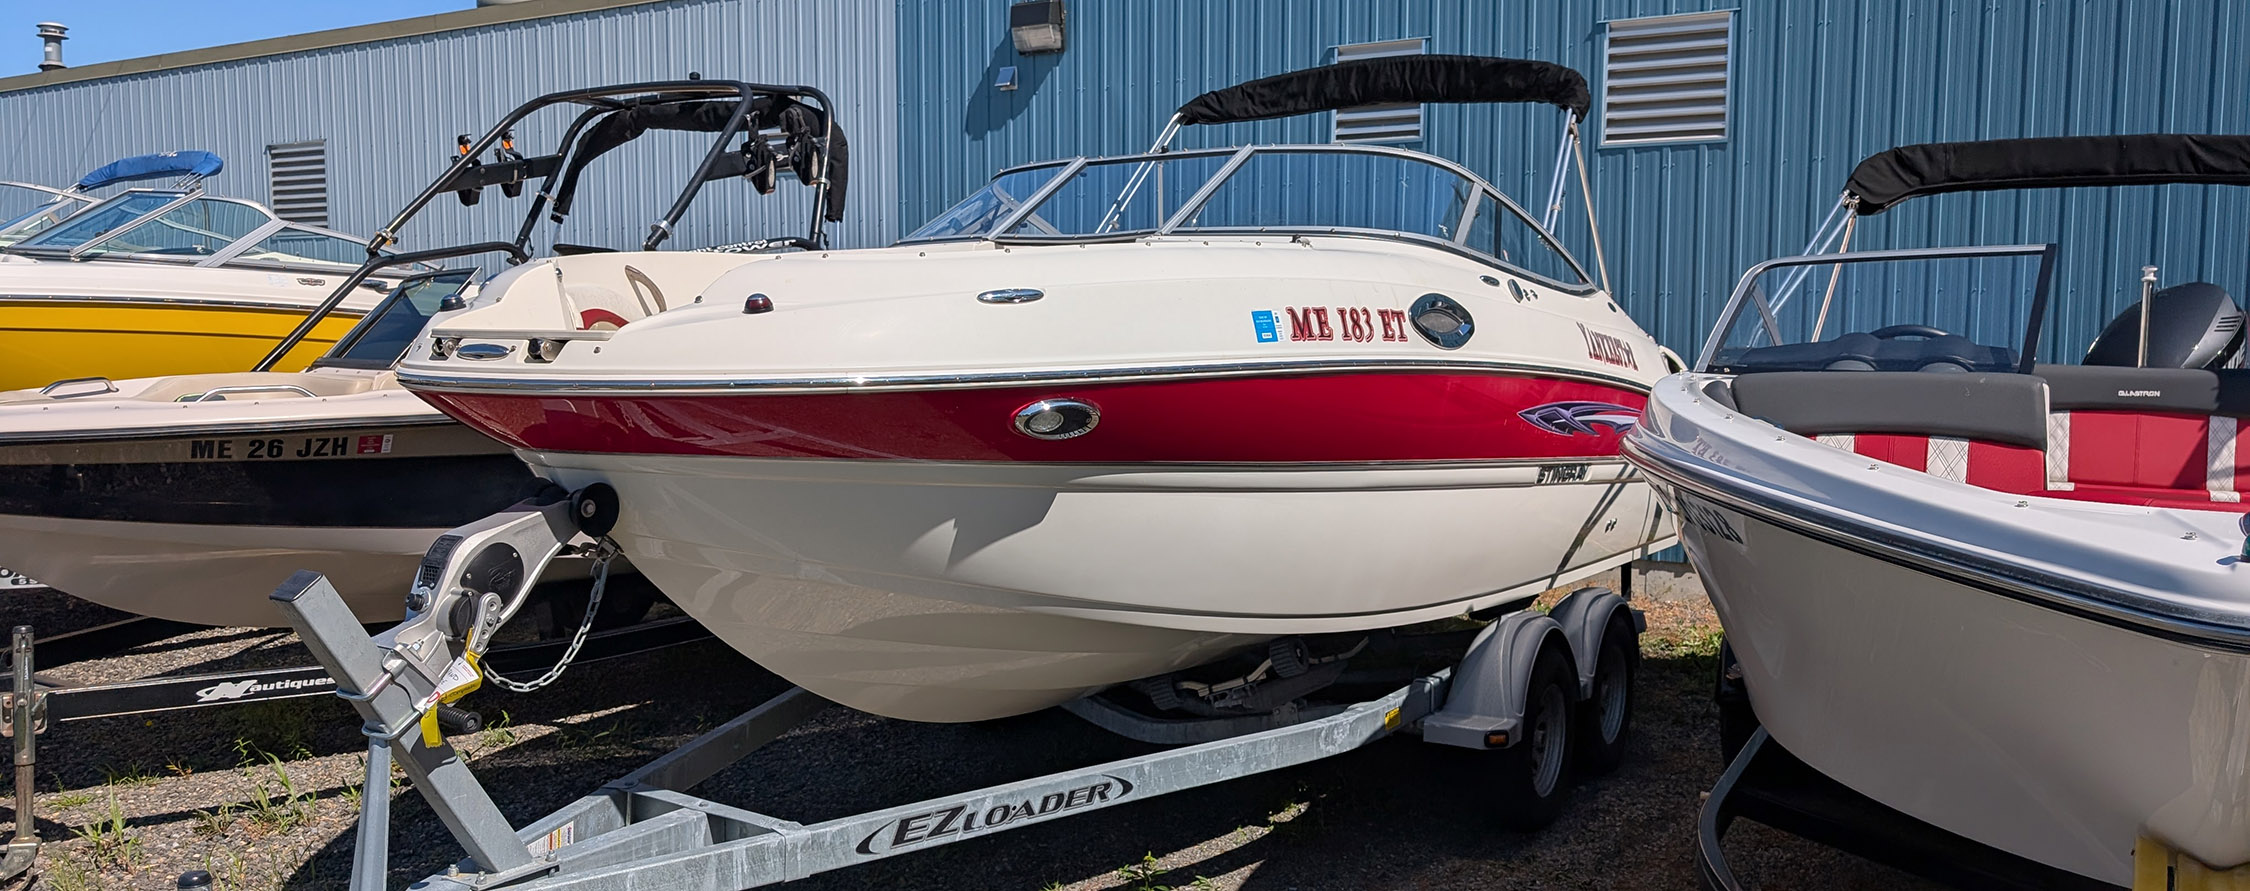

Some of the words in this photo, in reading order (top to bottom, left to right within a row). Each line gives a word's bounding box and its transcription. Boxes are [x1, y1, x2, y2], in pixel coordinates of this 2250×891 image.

[714, 239, 797, 253] ower
[717, 238, 768, 251] control
[1285, 306, 1334, 342] ME
[1336, 306, 1375, 343] 183
[1378, 308, 1409, 342] ET
[2117, 389, 2161, 397] GLASTRON
[190, 439, 233, 459] ME
[247, 438, 285, 459] 26
[296, 436, 349, 458] JZH
